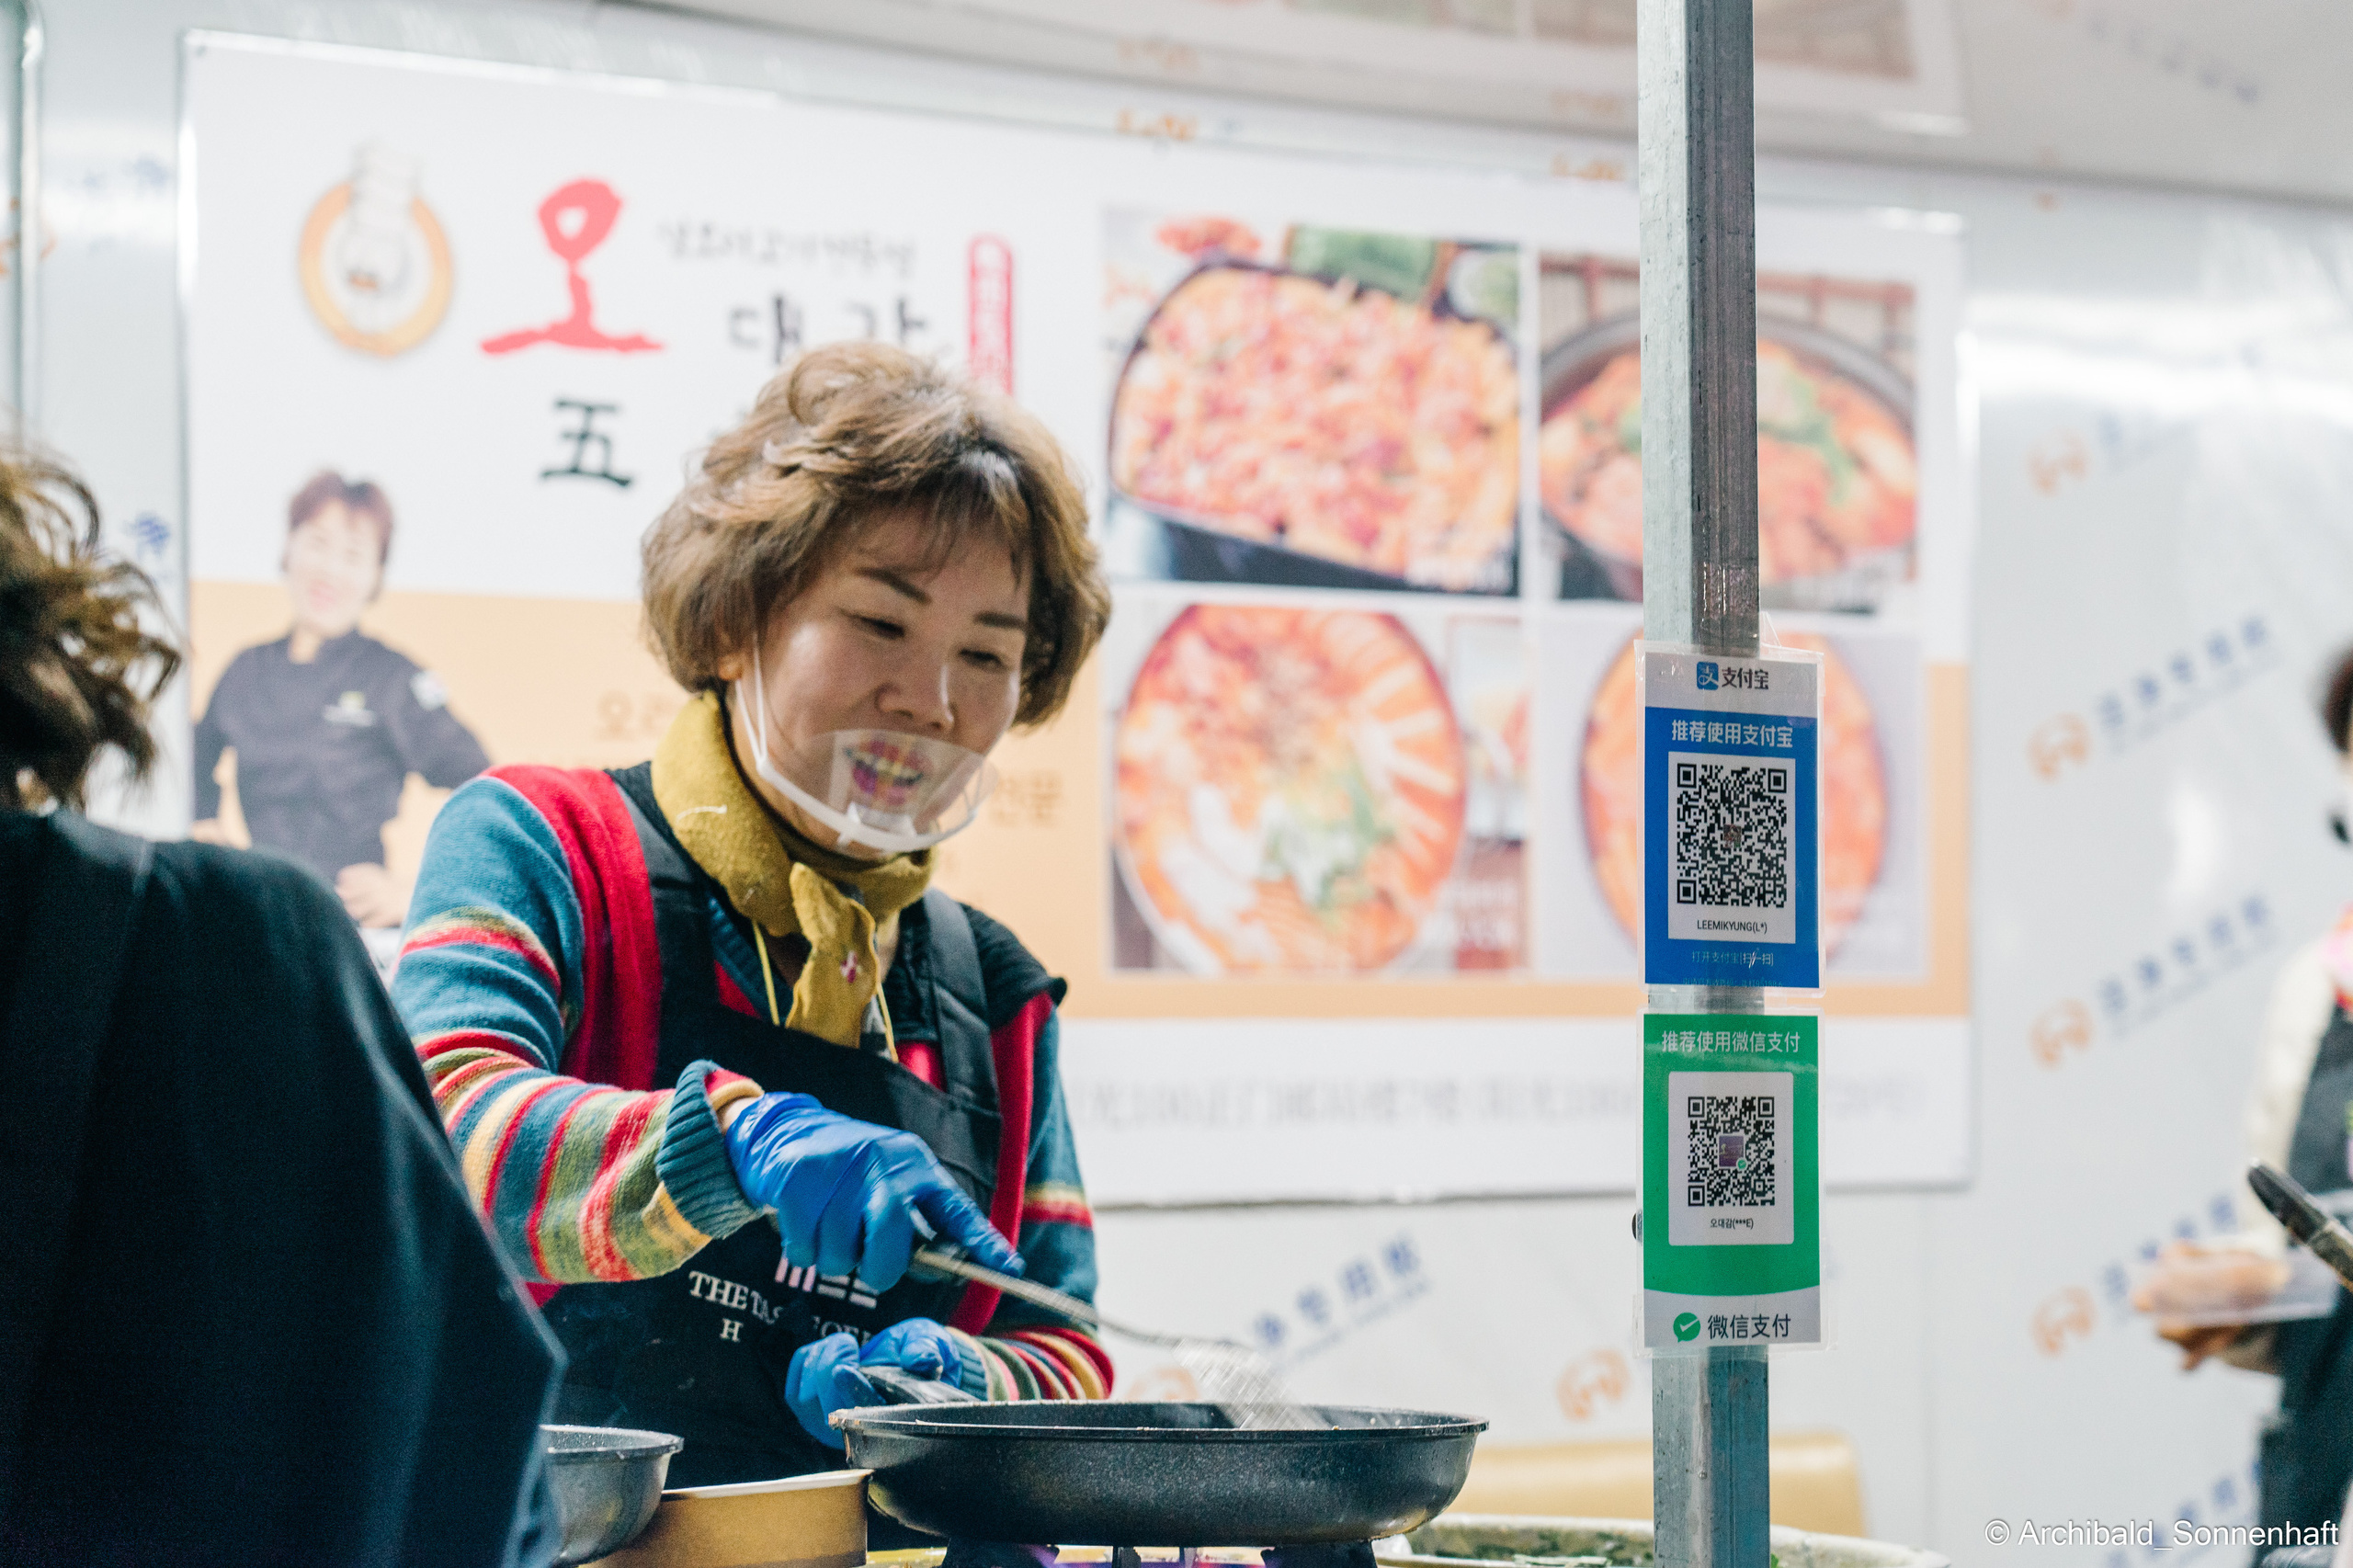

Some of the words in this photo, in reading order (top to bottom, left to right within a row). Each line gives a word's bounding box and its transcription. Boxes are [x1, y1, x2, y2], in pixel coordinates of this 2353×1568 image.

[480, 179, 666, 355] 오
[540, 396, 634, 488] 五
[1722, 666, 1769, 690] 支付宝
[1671, 719, 1793, 748] 推荐使用支付宝
[1661, 1030, 1801, 1054] 推荐使用微信支付
[688, 1270, 749, 1312] THE
[1707, 1312, 1791, 1339] 微信支付
